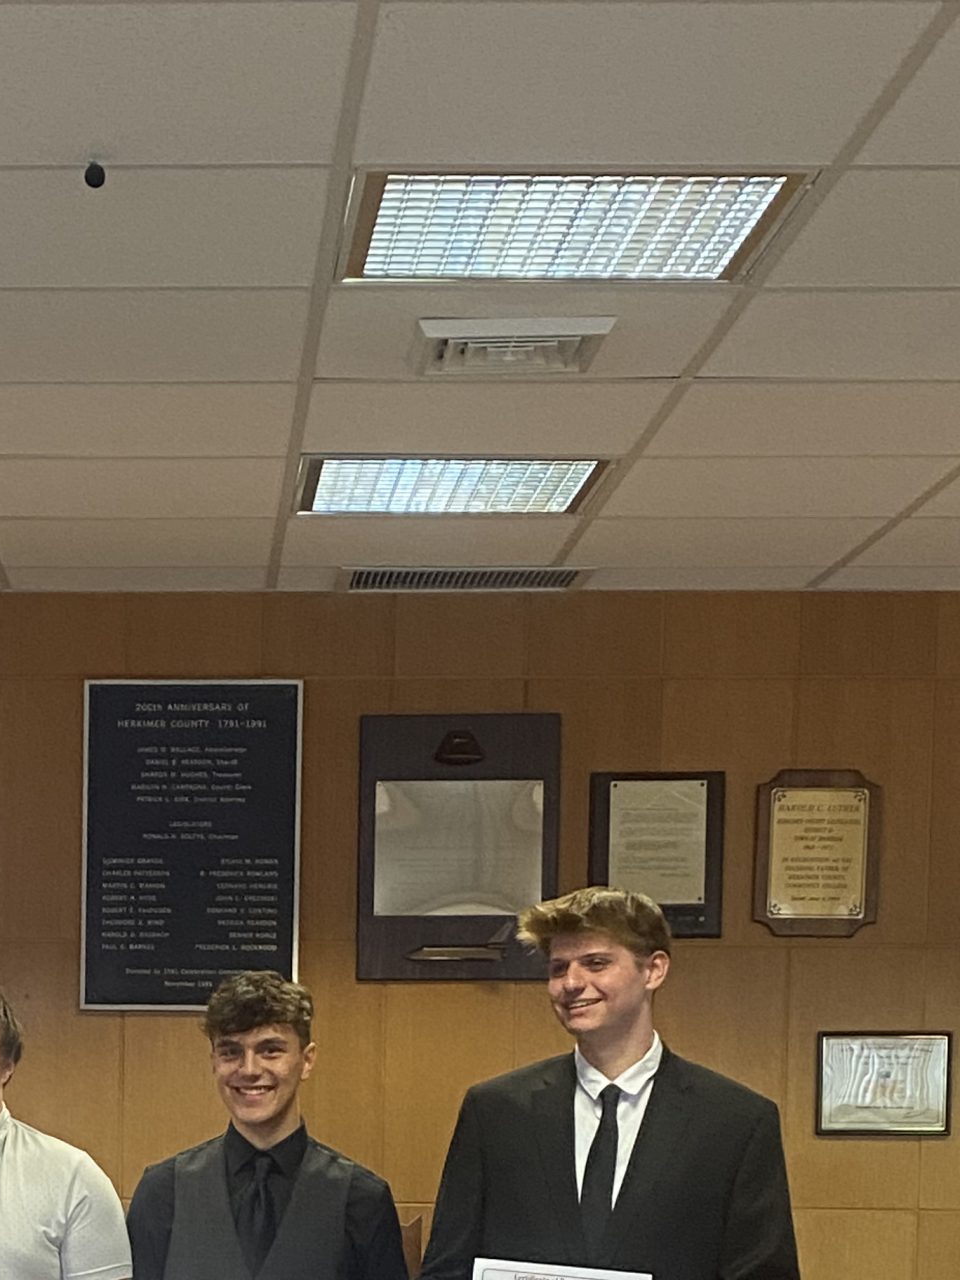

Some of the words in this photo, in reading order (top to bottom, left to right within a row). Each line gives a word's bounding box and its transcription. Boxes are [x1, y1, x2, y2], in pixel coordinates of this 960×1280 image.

[166, 703, 233, 711] ANNIVERSARY
[117, 719, 166, 728] HERKIMER
[169, 719, 210, 728] COUNTY
